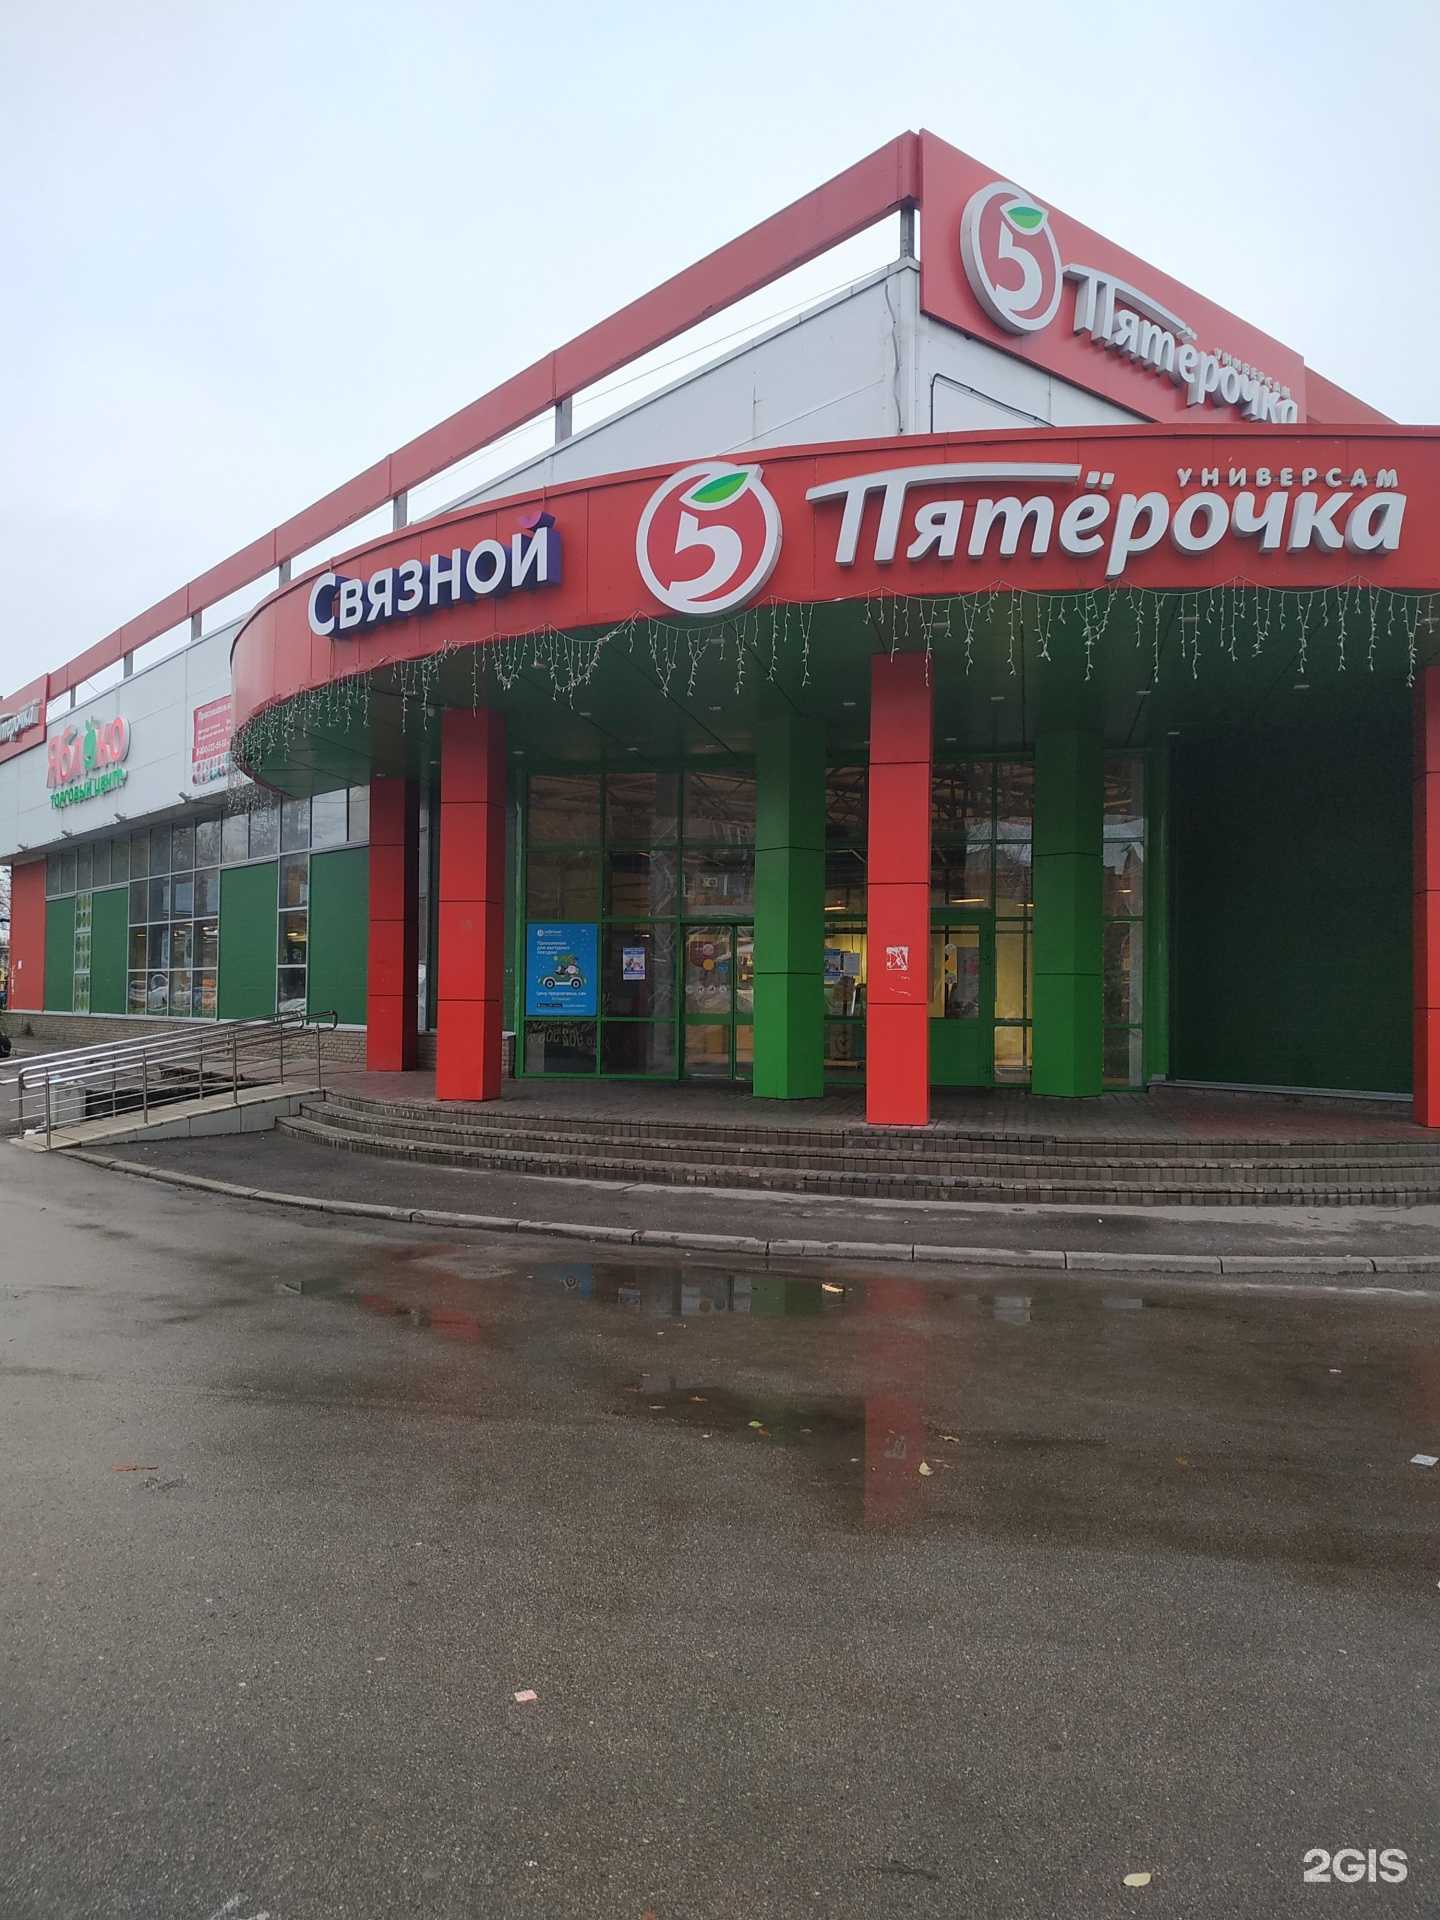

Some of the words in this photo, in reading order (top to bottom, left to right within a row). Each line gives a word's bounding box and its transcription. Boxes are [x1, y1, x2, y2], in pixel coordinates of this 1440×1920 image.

[1062, 263, 1298, 423] Пятёрочка
[805, 462, 1407, 580] Пятёрочка
[1177, 467, 1398, 488] УНИВЕРСАМ
[308, 512, 561, 637] СВЯЗНОЙ
